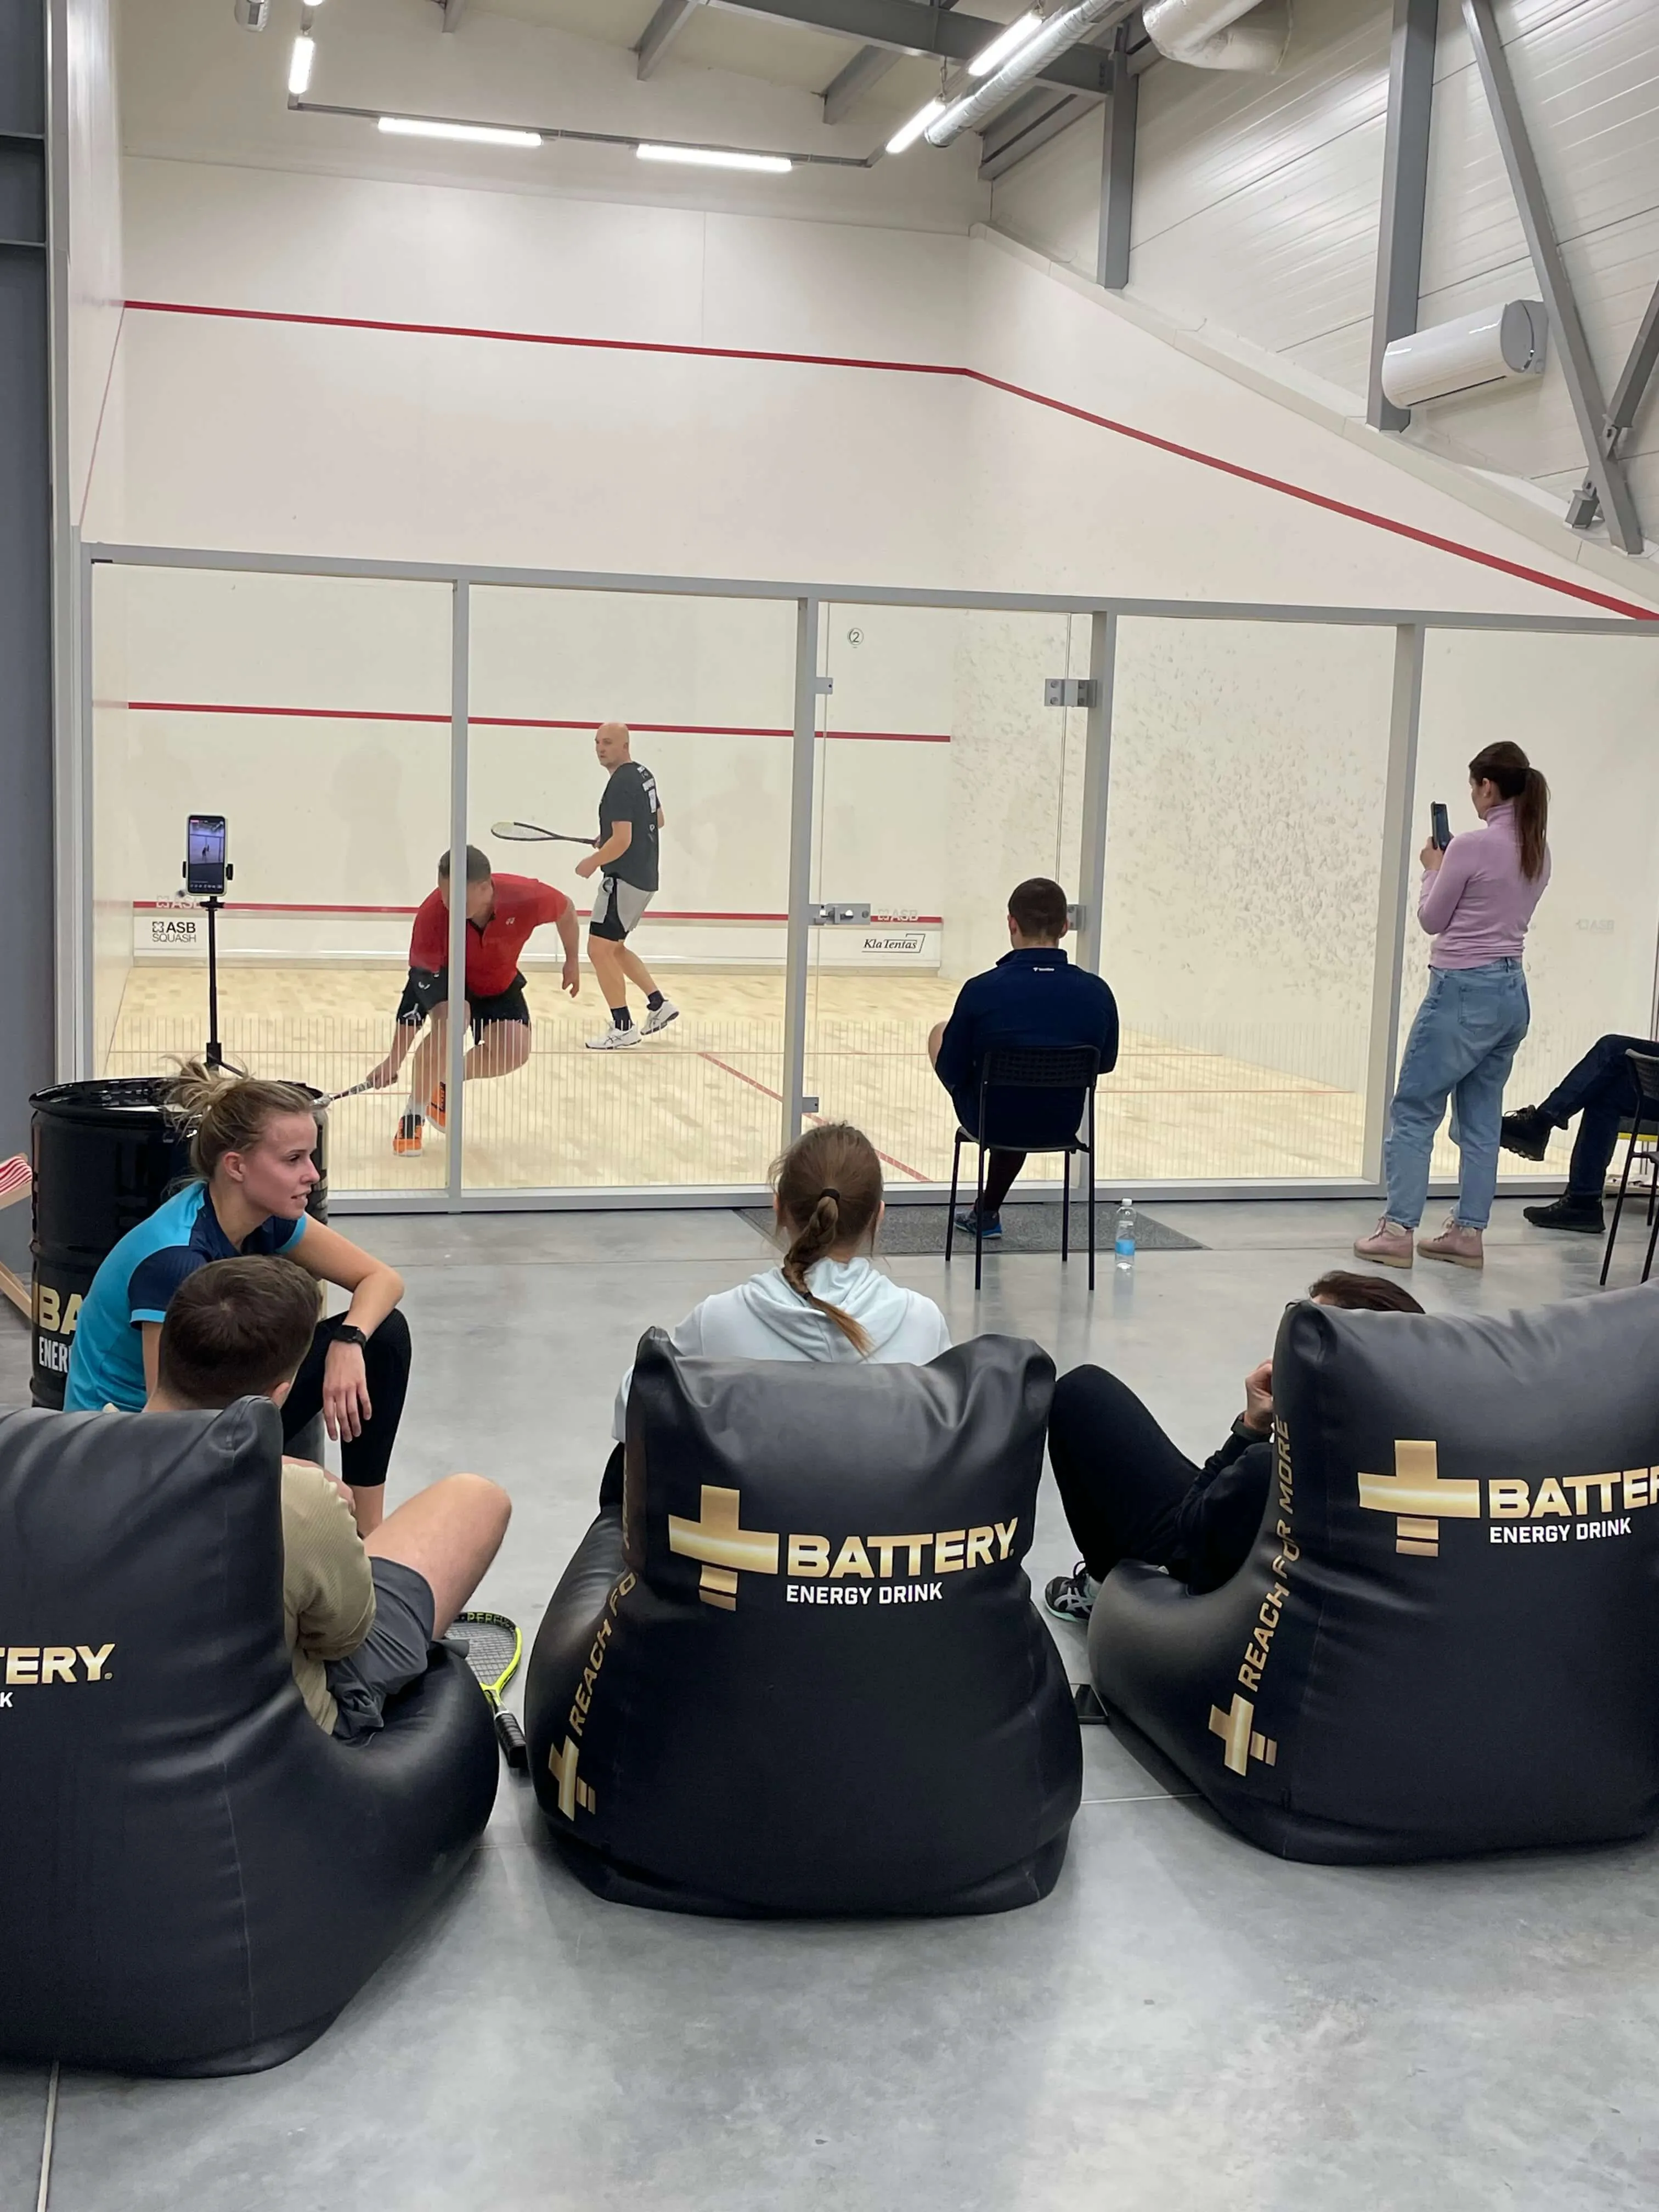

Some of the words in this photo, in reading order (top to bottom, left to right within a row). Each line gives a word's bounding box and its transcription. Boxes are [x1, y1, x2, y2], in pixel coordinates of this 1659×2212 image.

[166, 921, 196, 933] ASB
[889, 909, 919, 922] ASB
[152, 933, 197, 943] SQUASH
[39, 1336, 71, 1373] ENER
[1275, 1414, 1294, 1515] MORE
[787, 1516, 1019, 1578] BATTERY
[1489, 1524, 1571, 1543] ENERGY
[1576, 1517, 1632, 1541] DRINK
[1272, 1519, 1300, 1580] FOR
[786, 1584, 872, 1605] ENERGY
[879, 1582, 943, 1605] DRINK
[568, 1618, 612, 1736] REACH
[609, 1571, 639, 1617] FO
[1238, 1582, 1290, 1692] REACH
